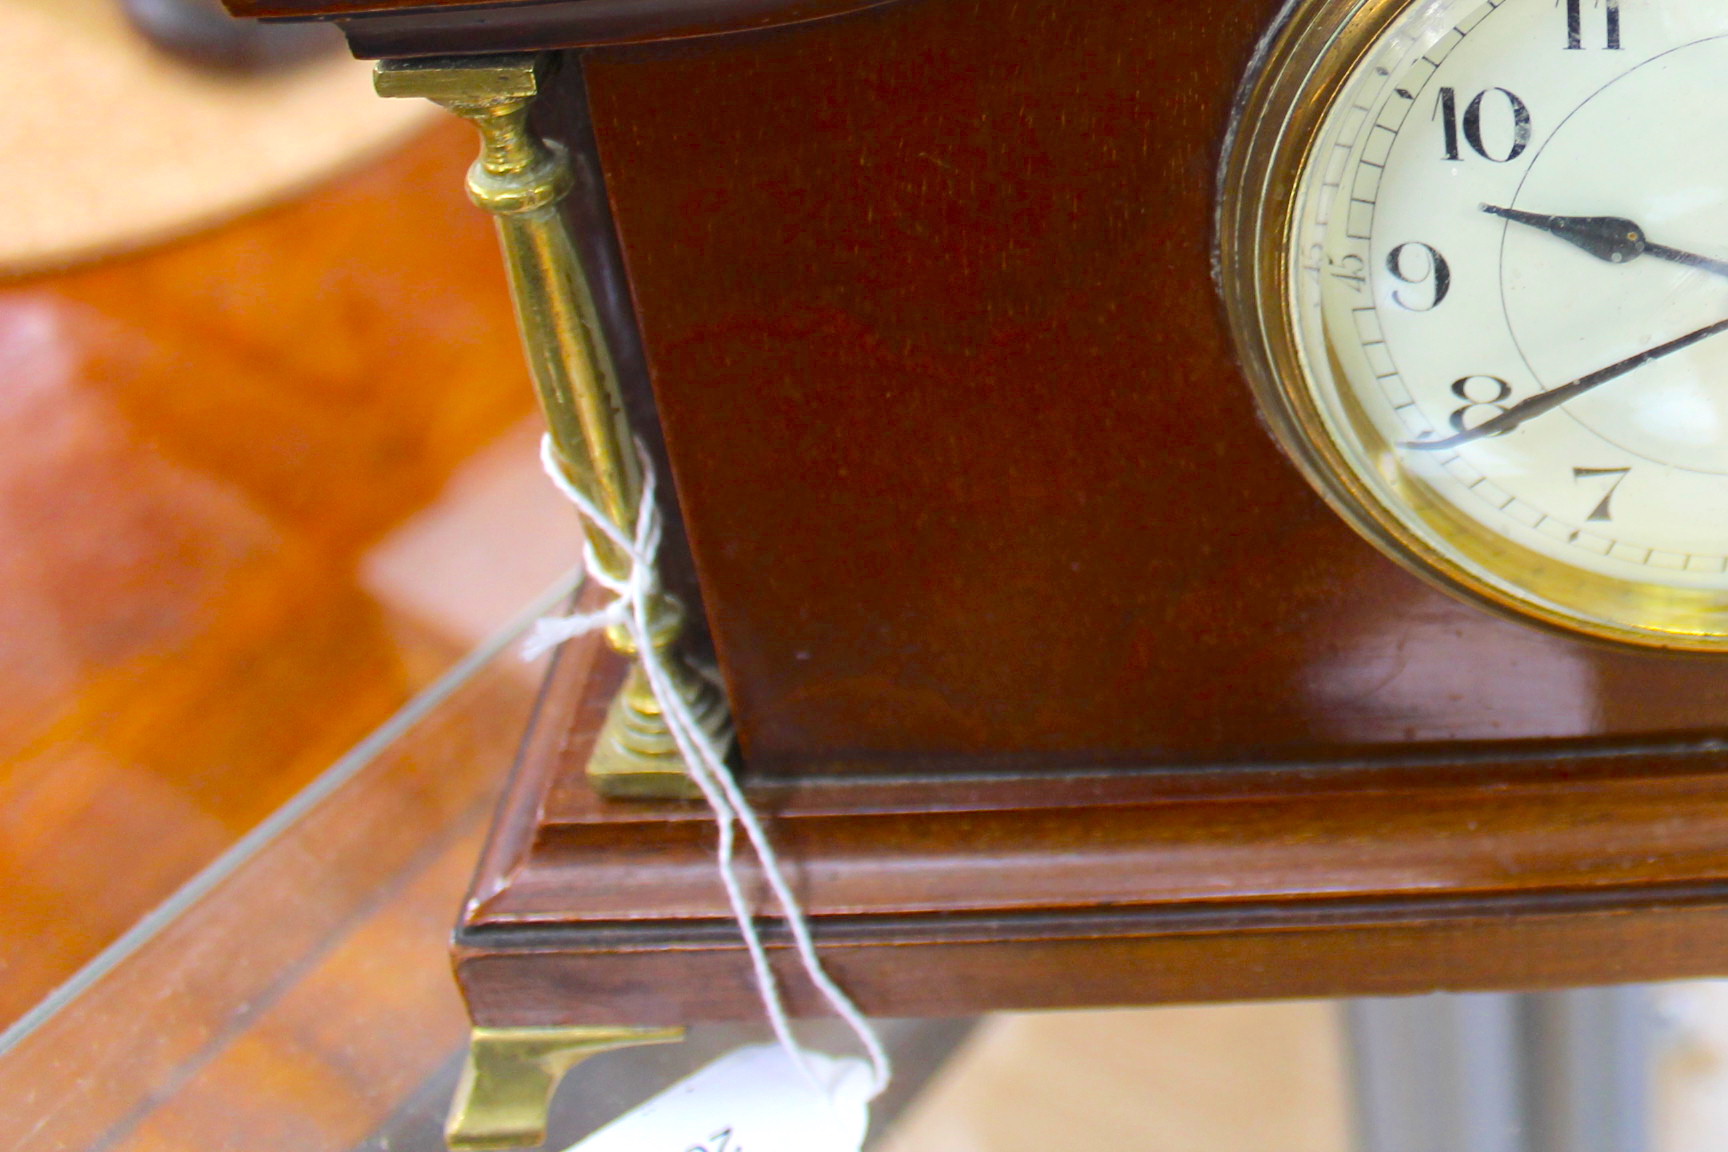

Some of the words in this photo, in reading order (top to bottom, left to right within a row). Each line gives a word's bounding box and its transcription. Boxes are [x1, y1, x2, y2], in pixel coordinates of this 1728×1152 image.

[1431, 86, 1532, 163] 10
[1385, 241, 1451, 312] 9
[1449, 374, 1520, 438] 8
[1572, 466, 1632, 522] 7
